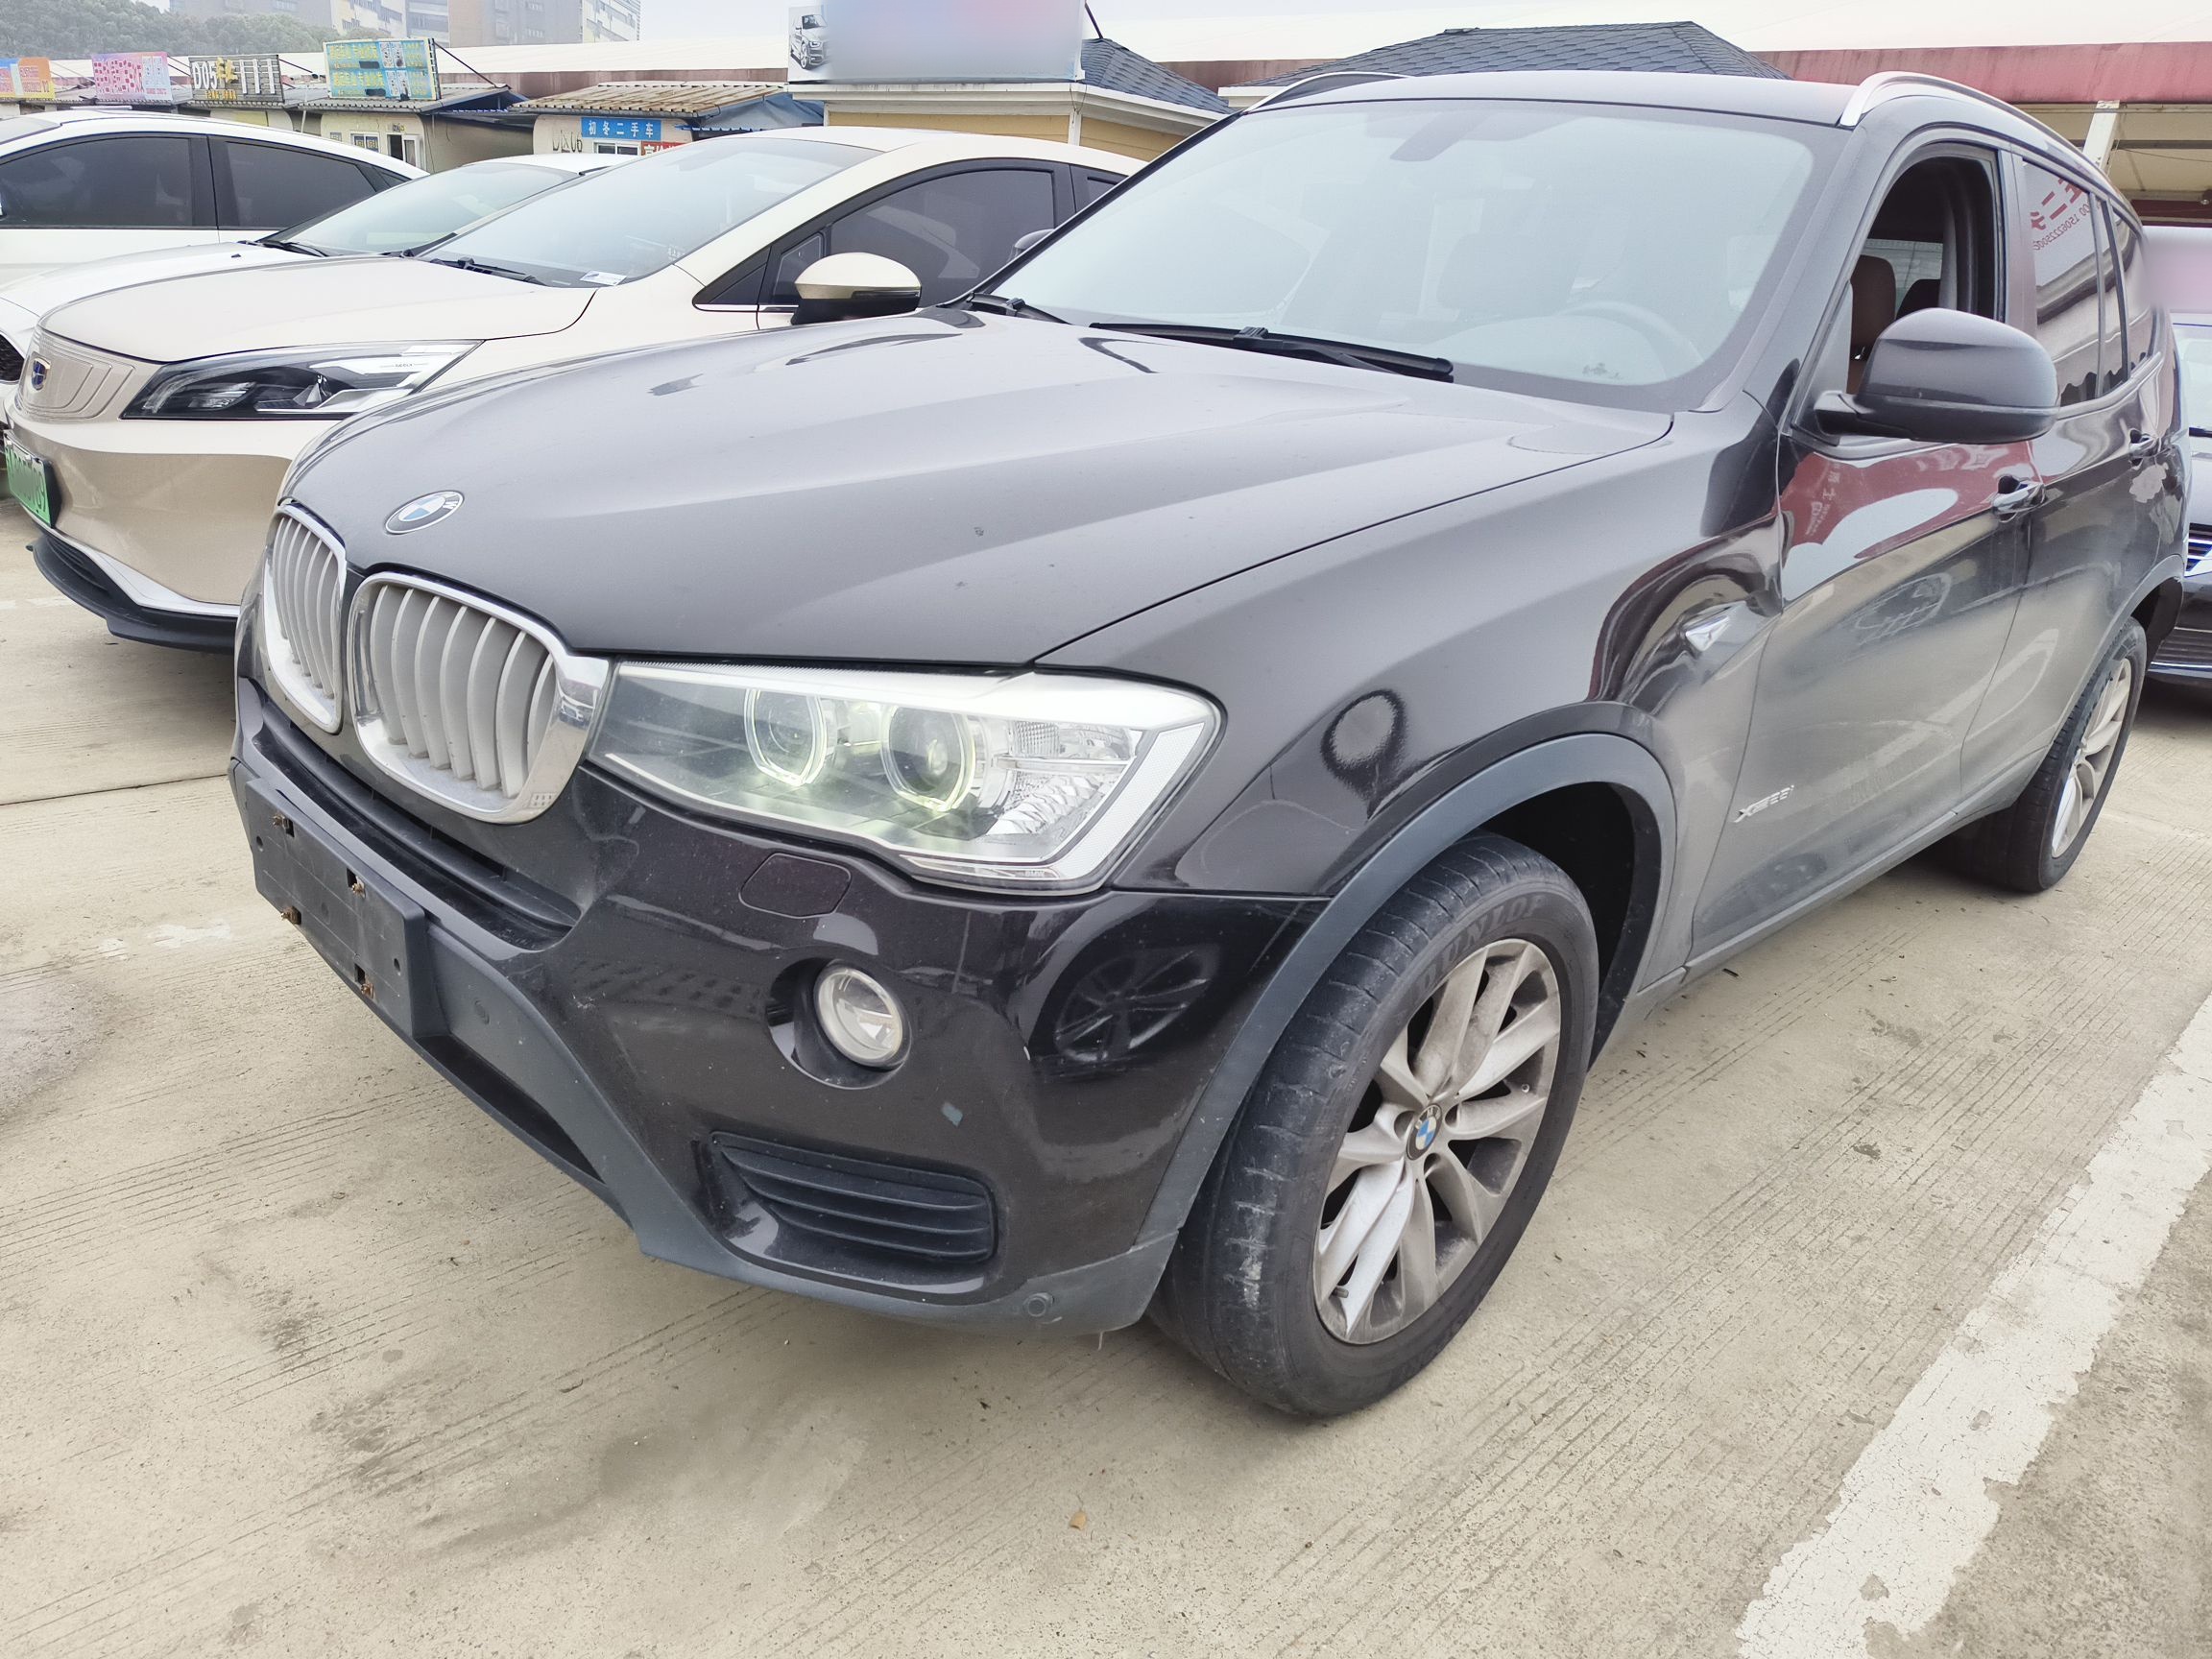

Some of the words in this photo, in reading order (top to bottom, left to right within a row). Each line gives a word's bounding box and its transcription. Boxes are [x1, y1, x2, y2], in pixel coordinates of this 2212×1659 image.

[589, 119, 654, 138] 初冬二手车
[1422, 895, 1545, 989] DUNLOP
